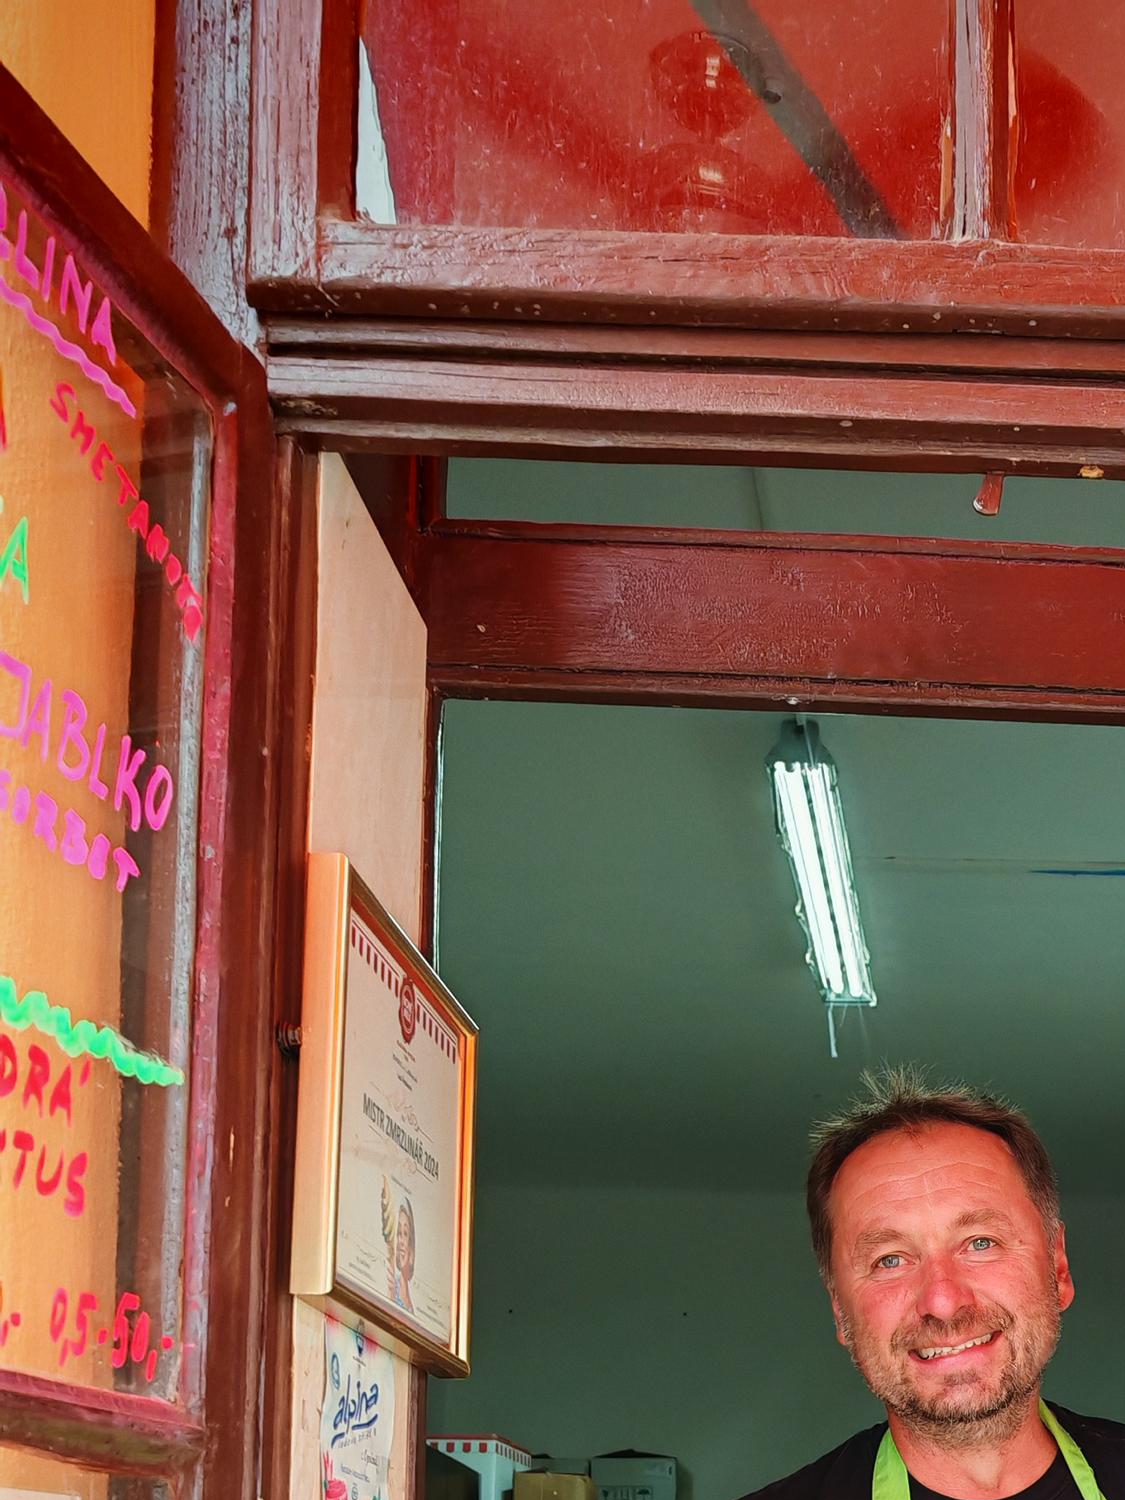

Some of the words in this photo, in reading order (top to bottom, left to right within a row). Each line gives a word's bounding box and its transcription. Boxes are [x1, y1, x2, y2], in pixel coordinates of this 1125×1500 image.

[0, 182, 118, 367] LINA
[0, 653, 173, 832] JABLKO
[363, 1092, 385, 1133] MISTR
[385, 1115, 424, 1167] ZMRZLINÁŘ
[423, 1151, 440, 1181] 2024
